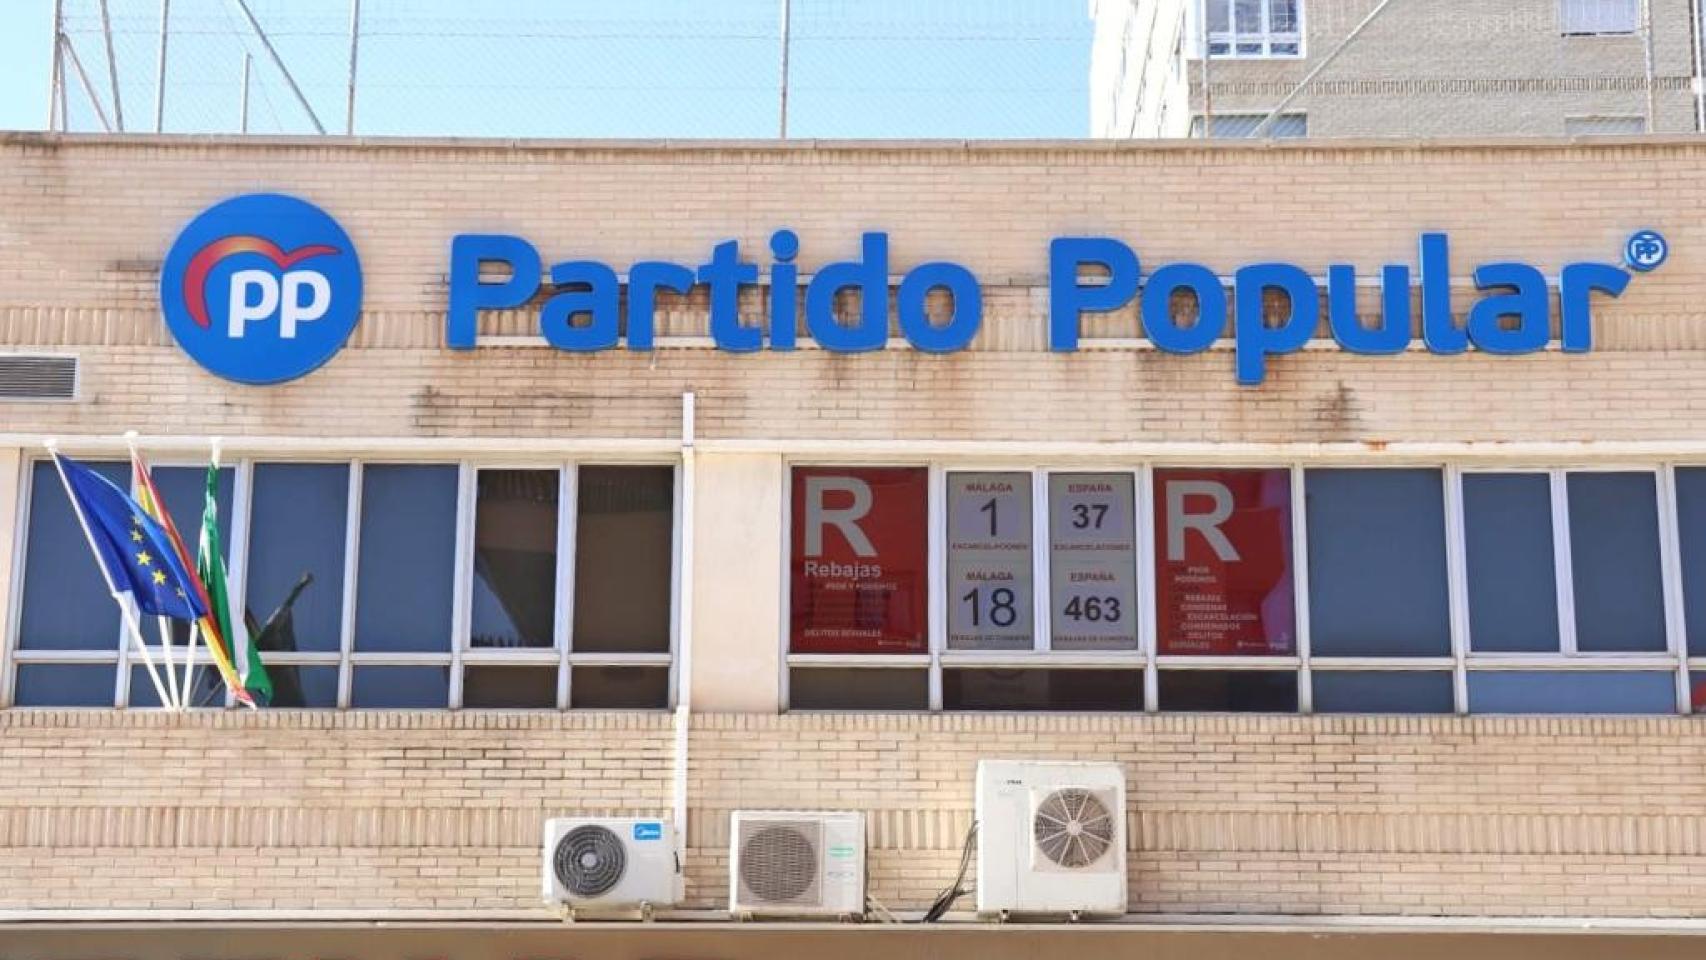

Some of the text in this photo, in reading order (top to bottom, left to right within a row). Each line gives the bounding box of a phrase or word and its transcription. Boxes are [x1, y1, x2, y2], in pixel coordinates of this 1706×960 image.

[227, 269, 331, 338] pp
[447, 229, 1632, 386] Partido Popular
[804, 475, 877, 558] R
[980, 498, 997, 537] 1
[1072, 504, 1109, 529] 37
[1165, 480, 1241, 561] R
[804, 561, 882, 581] Rebajas
[962, 588, 1017, 628] 18
[1064, 596, 1121, 622] 463
